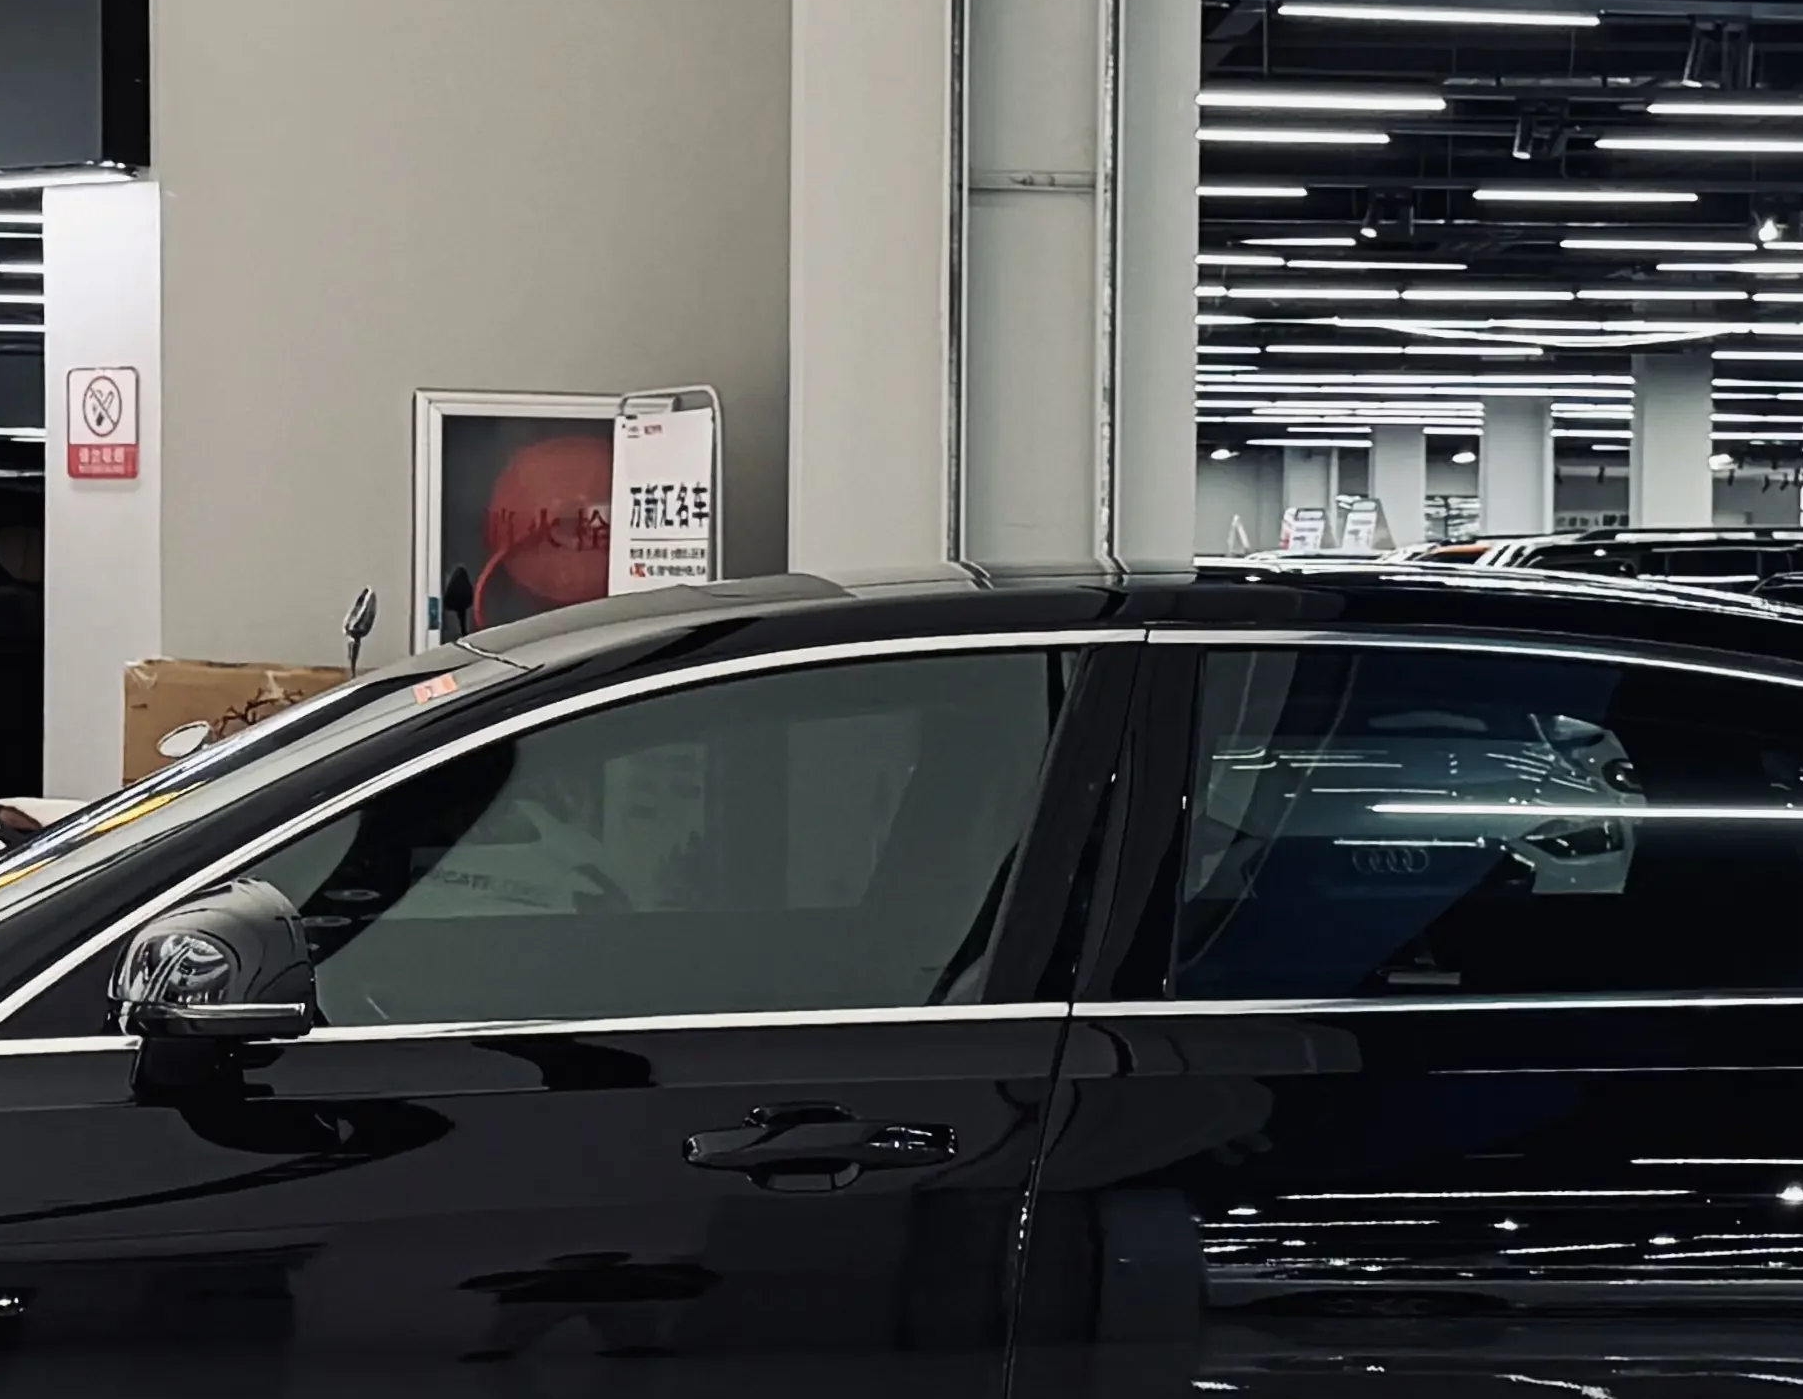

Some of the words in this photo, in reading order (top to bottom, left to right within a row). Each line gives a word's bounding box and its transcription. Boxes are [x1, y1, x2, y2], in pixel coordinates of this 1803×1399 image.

[630, 481, 710, 529] 万新汇名车
